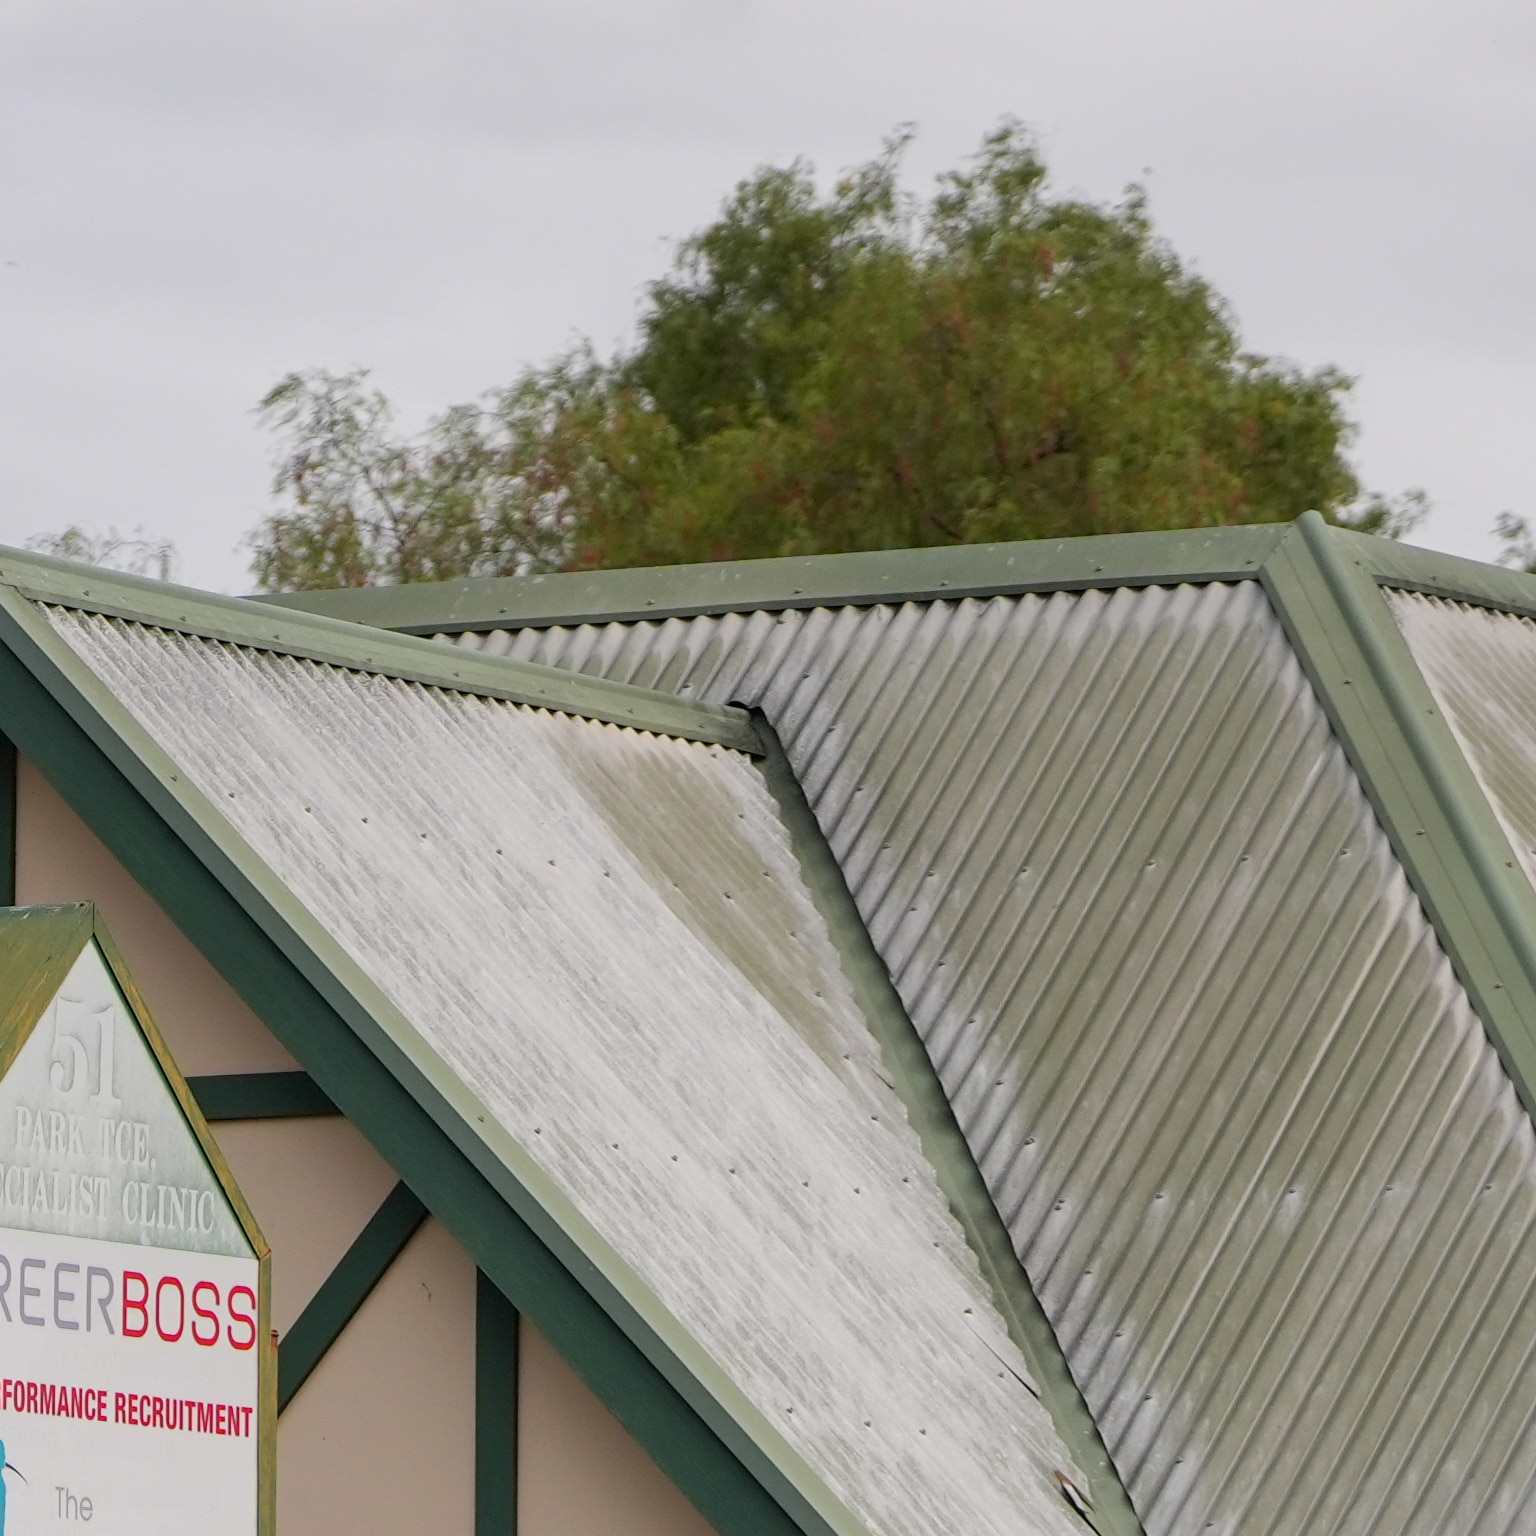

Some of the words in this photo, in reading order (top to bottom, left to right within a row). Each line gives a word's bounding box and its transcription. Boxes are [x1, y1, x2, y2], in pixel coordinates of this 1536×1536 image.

[49, 996, 123, 1106] 51
[15, 1105, 85, 1157] PARK
[122, 1180, 217, 1232] CLINIC
[115, 1396, 253, 1438] RECRUITMENT
[55, 1487, 94, 1521] The
